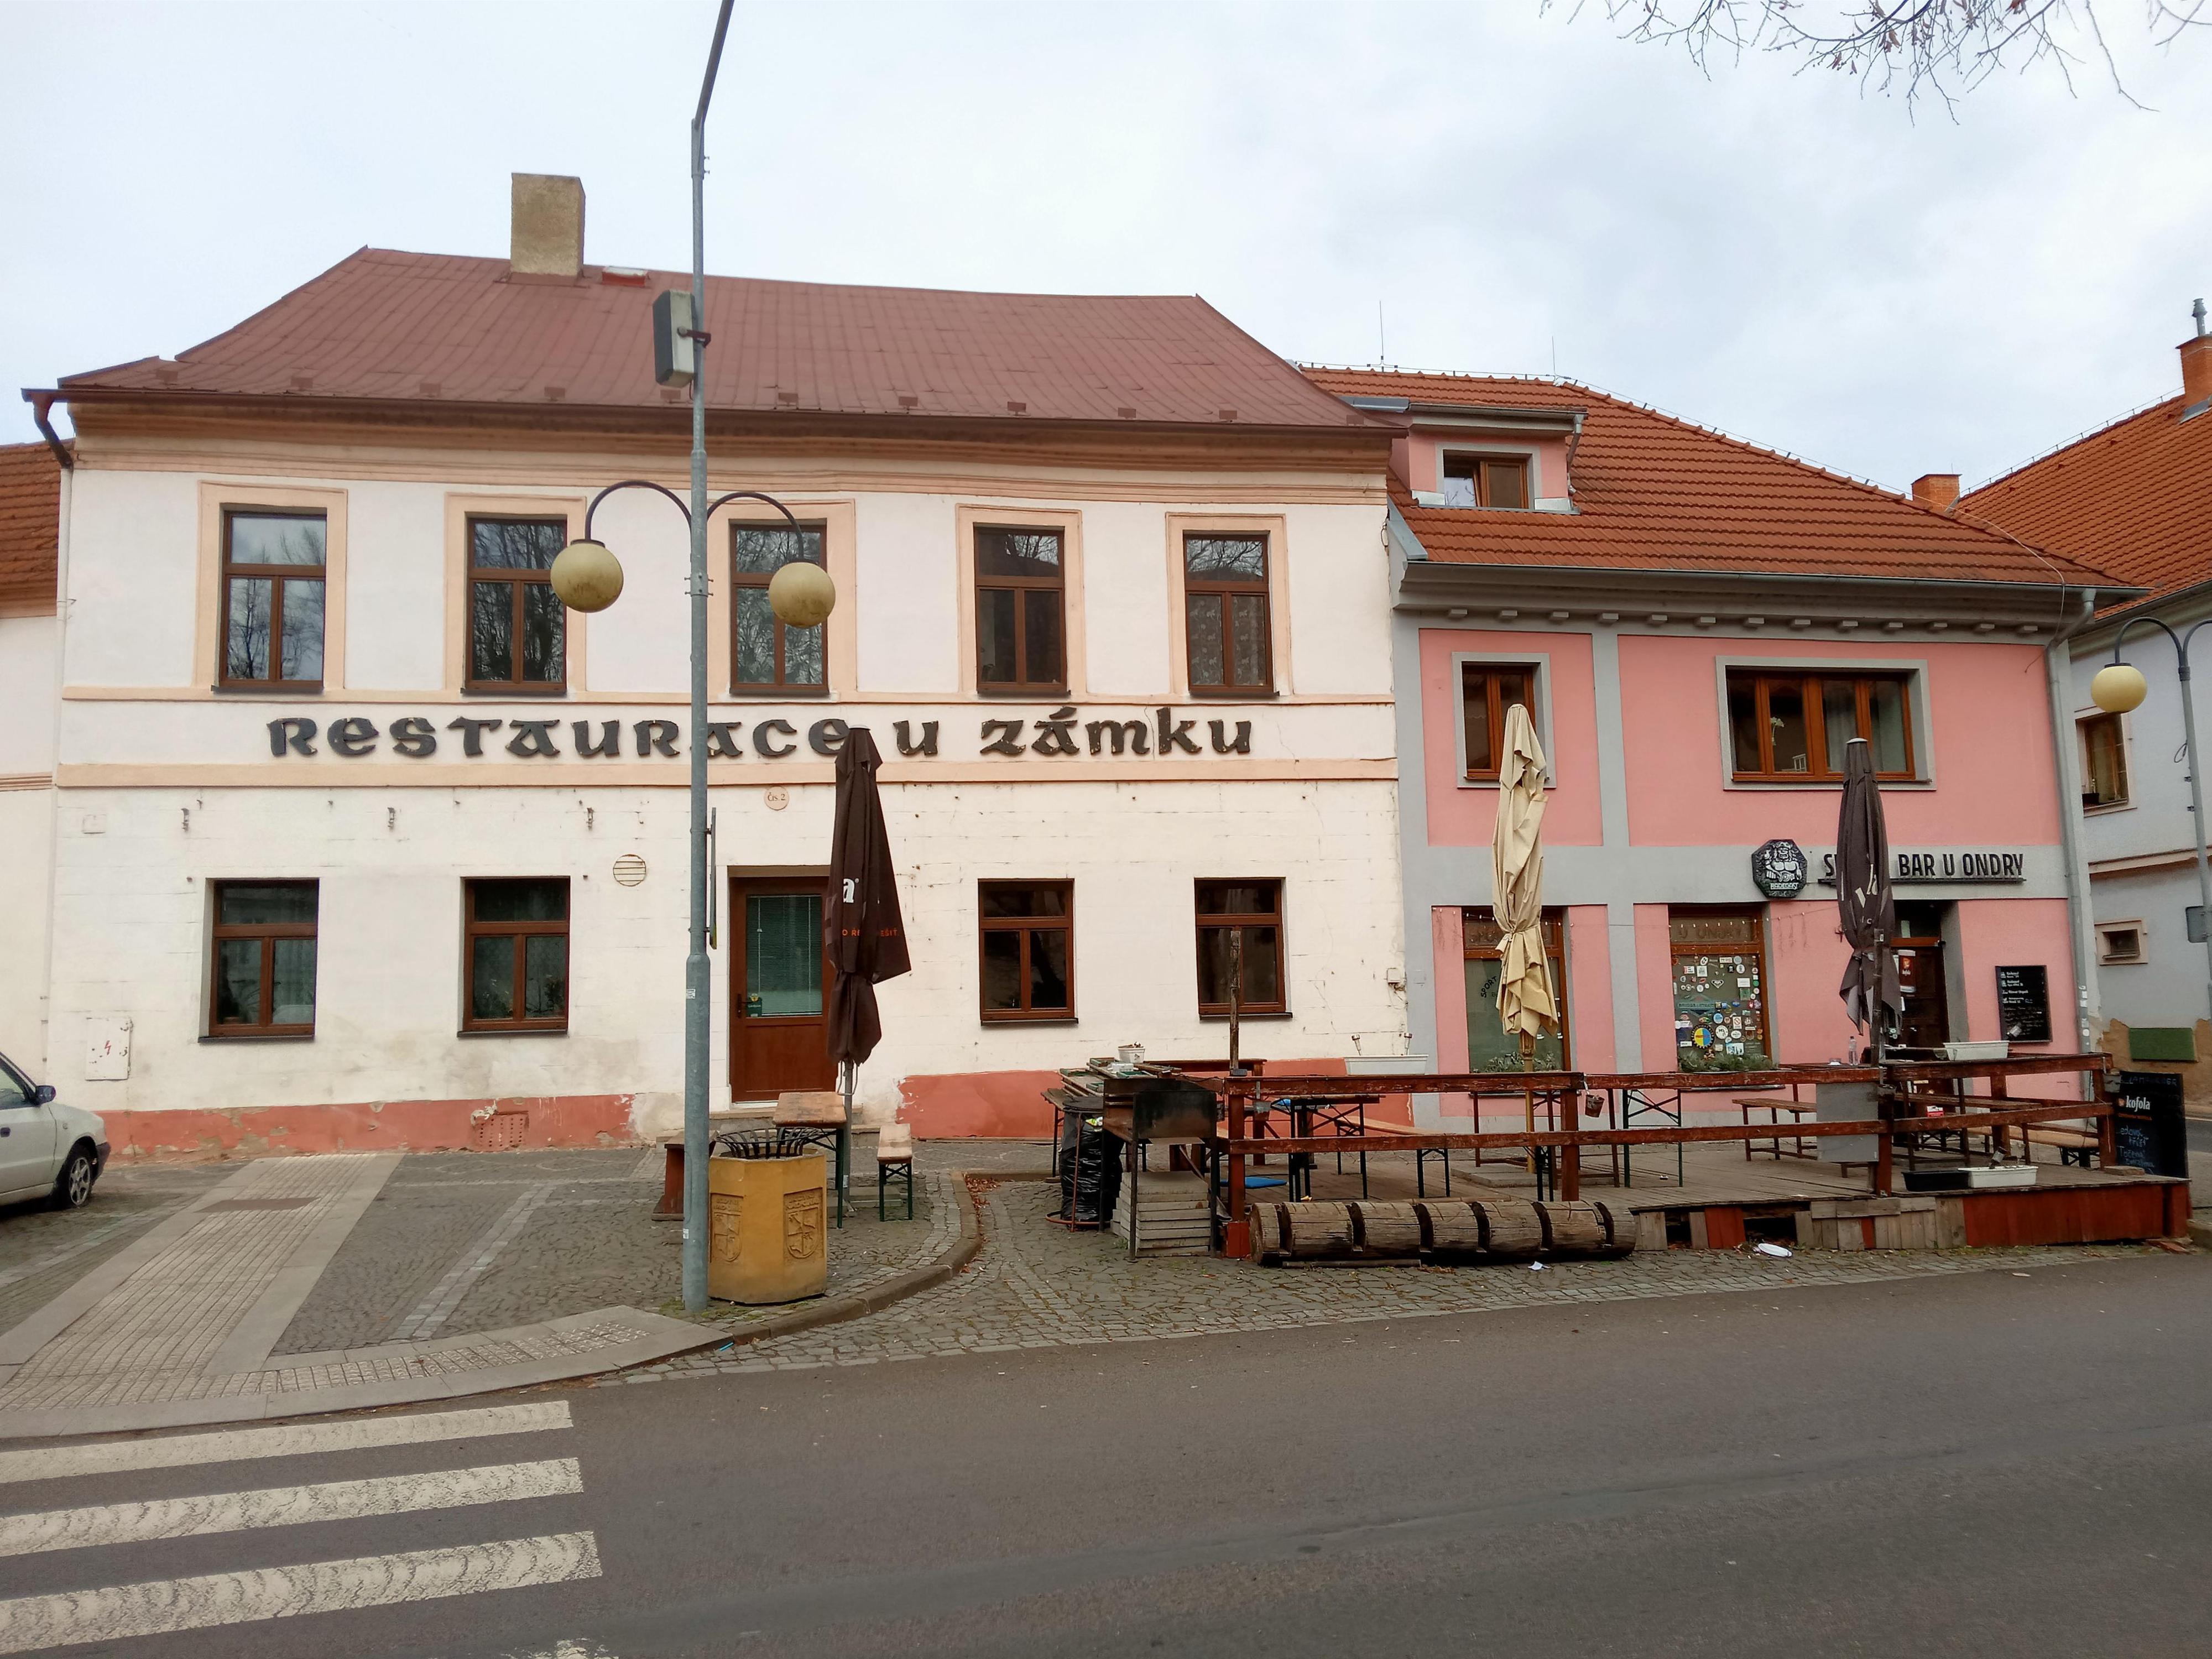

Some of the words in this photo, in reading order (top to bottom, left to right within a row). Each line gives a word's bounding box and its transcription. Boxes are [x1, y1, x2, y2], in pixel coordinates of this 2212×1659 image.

[1898, 853, 1936, 877] BAR
[1943, 853, 1955, 876] U
[1963, 853, 2023, 876] ONDRY
[1480, 976, 1497, 998] SPORT
[2126, 1095, 2151, 1112] kofola
